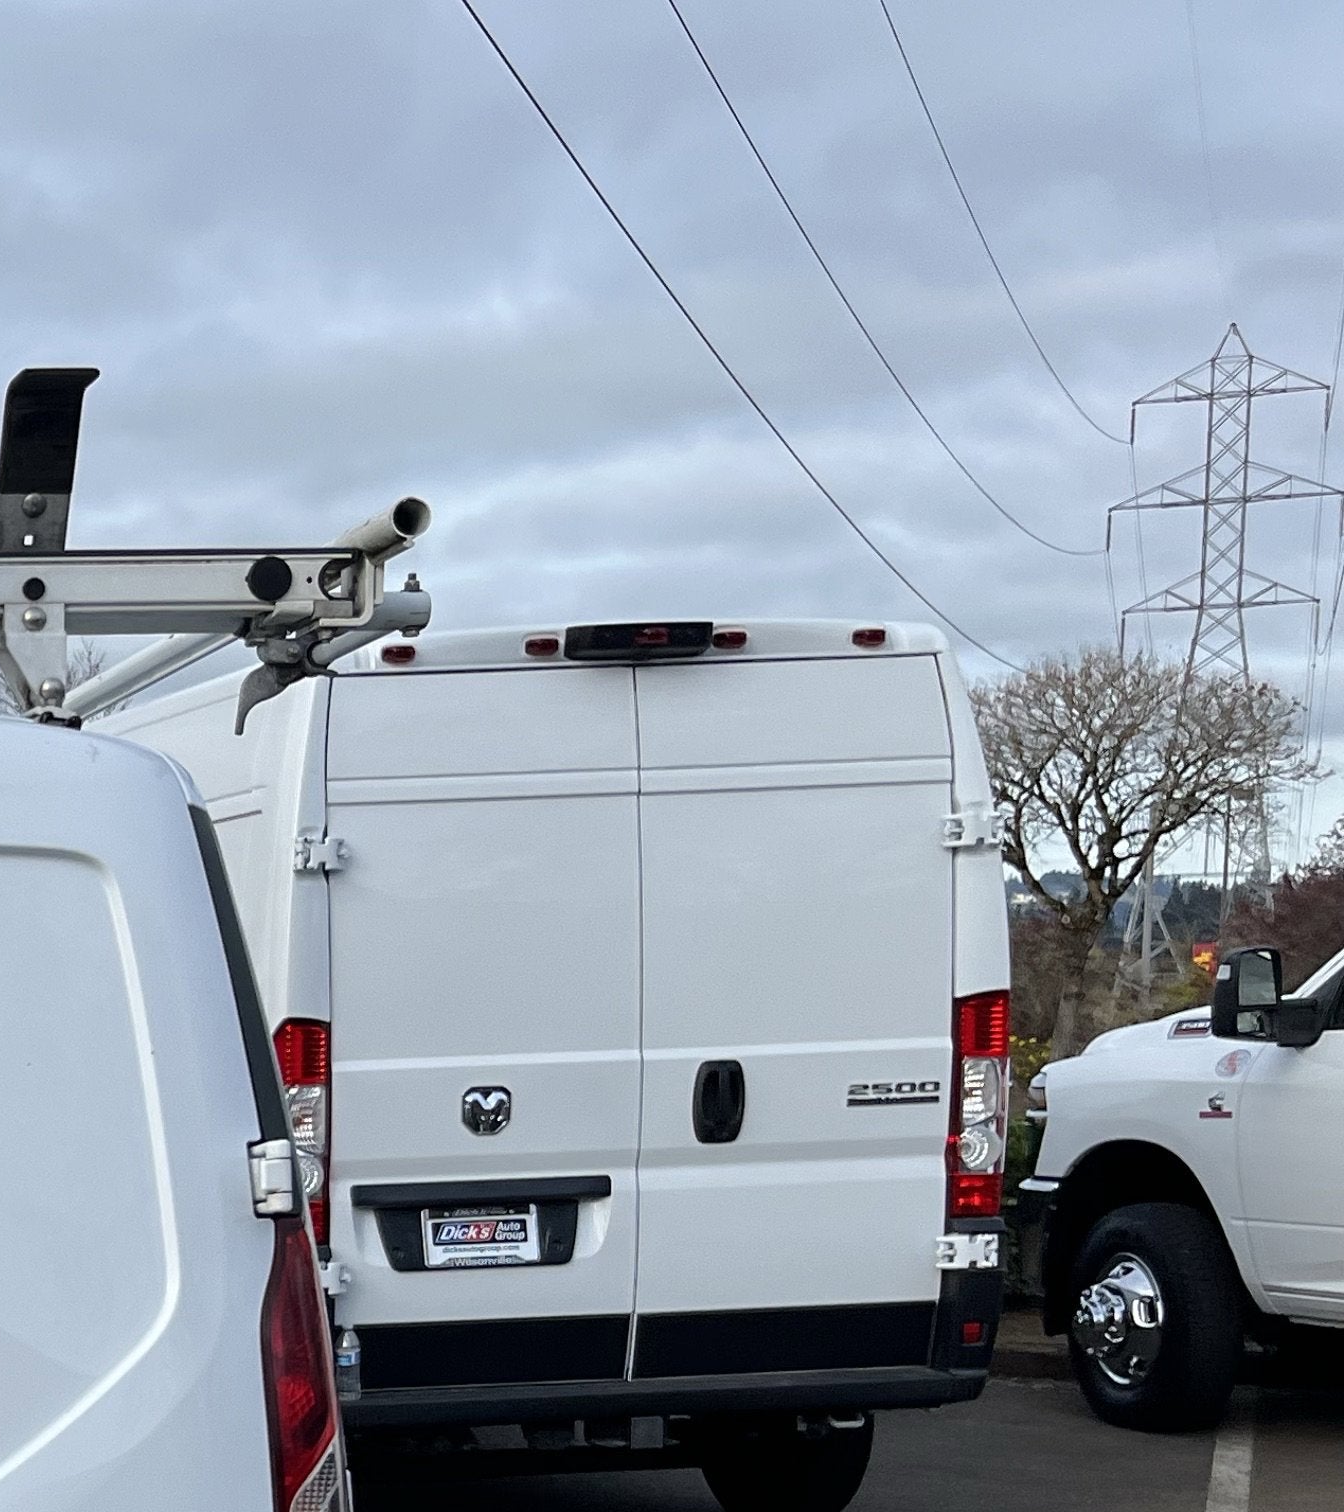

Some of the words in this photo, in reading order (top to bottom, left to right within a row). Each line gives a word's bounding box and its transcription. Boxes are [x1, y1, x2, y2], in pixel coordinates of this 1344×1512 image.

[847, 1081, 941, 1095] 2500
[440, 1223, 491, 1241] Dick's
[496, 1221, 521, 1231] Auto
[494, 1230, 526, 1241] Group
